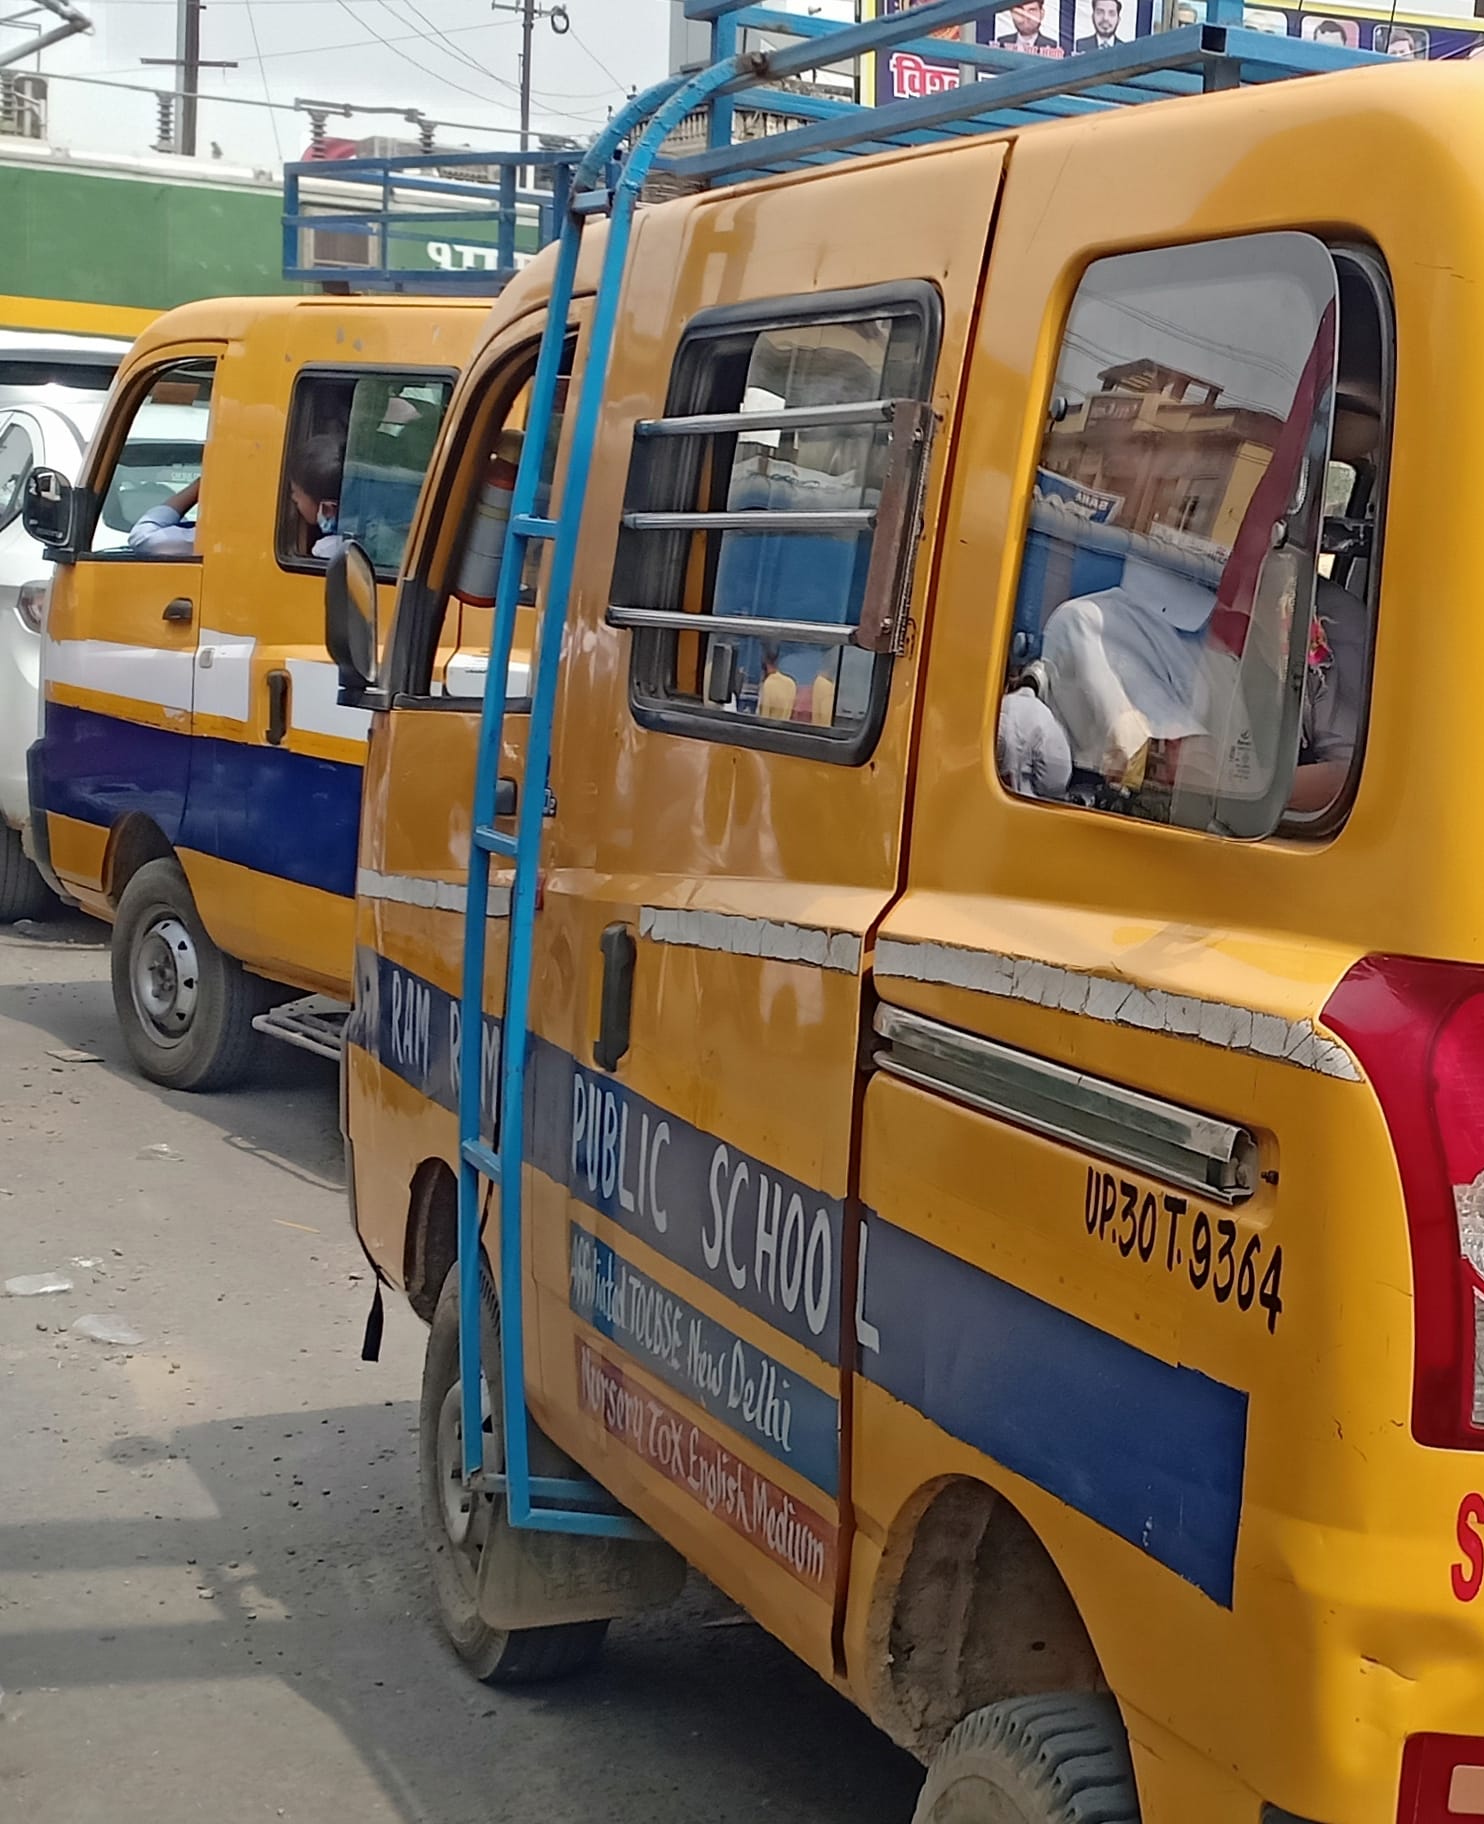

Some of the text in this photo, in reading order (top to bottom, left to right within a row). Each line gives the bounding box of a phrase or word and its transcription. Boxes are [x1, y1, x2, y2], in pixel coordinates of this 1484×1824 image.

[391, 969, 431, 1080] RAM
[450, 1000, 501, 1123] RM
[572, 1072, 670, 1234] PUBLIC
[727, 1339, 792, 1452] Delhi
